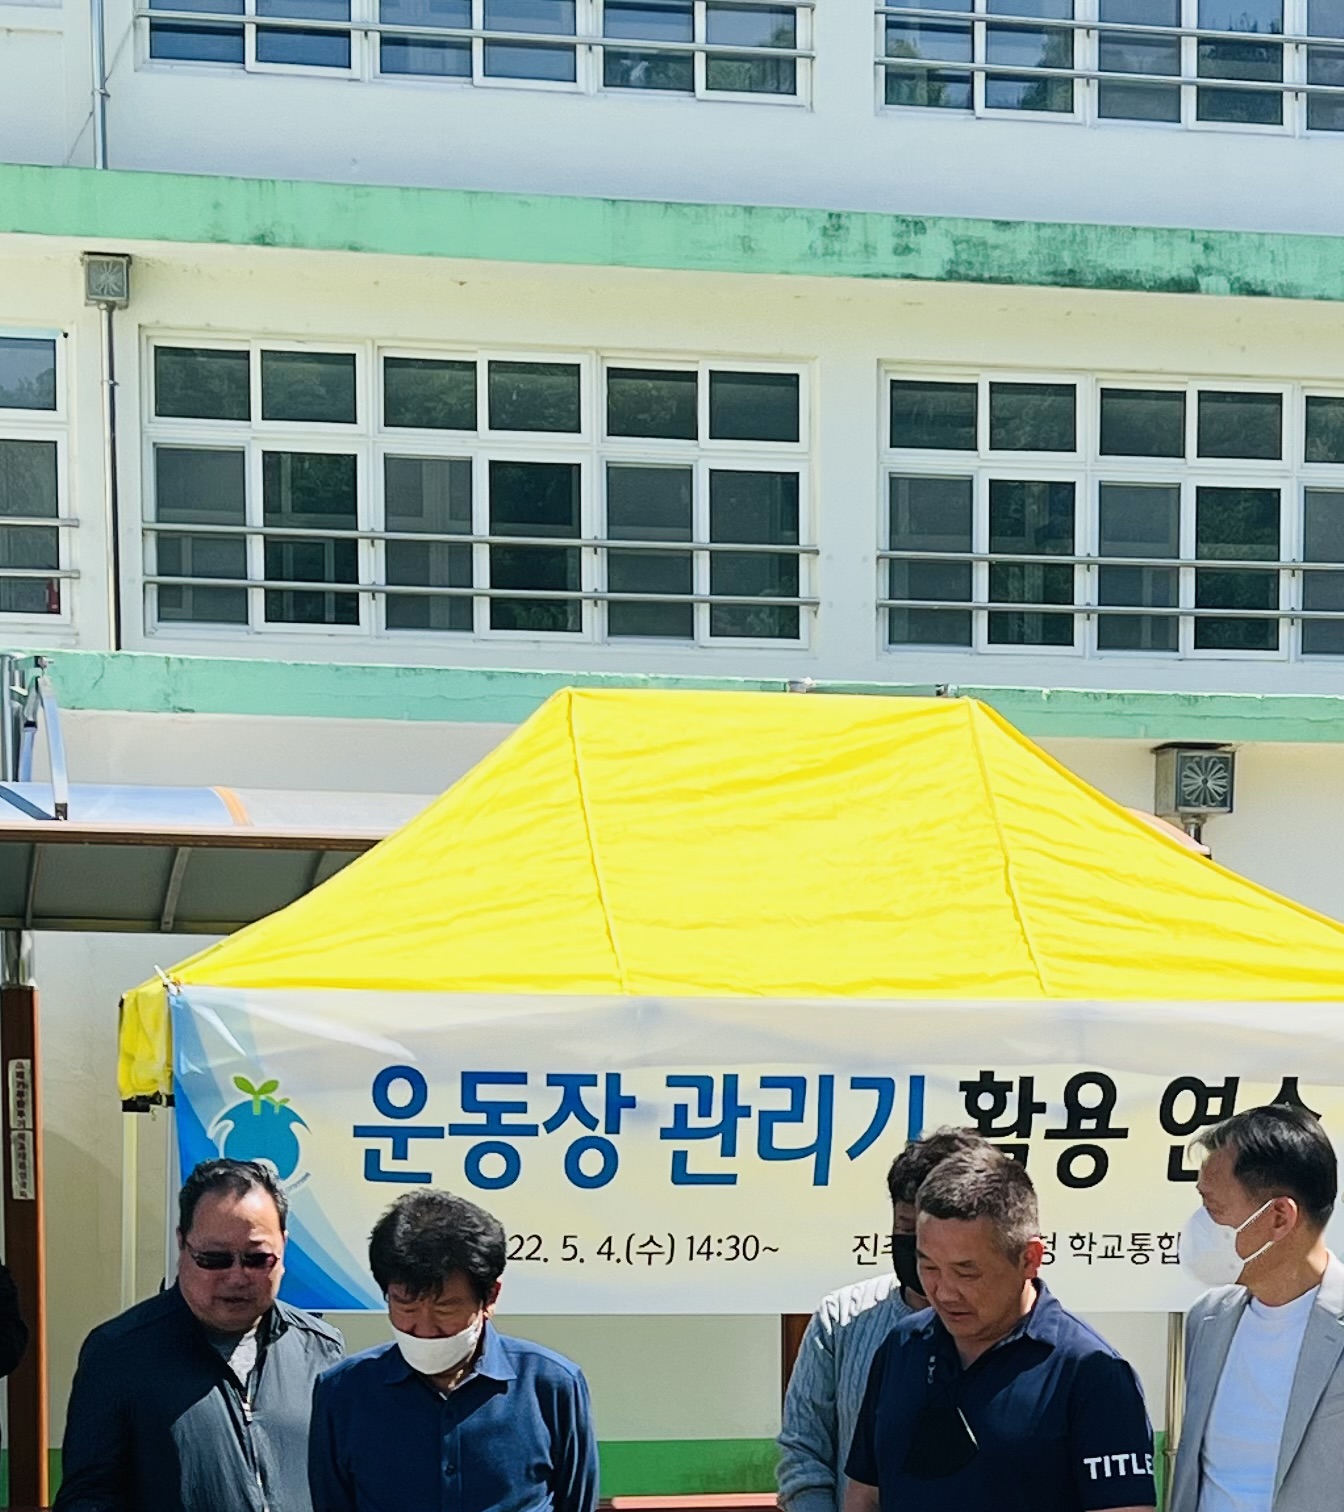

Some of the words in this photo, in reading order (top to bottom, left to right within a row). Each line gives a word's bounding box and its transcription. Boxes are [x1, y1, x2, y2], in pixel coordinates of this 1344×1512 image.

[353, 1064, 637, 1190] 운동장
[659, 1073, 926, 1186] 관리기
[561, 1235, 585, 1263] 5.
[686, 1234, 780, 1262] 14:30~
[1068, 1232, 1182, 1265] 학교통합
